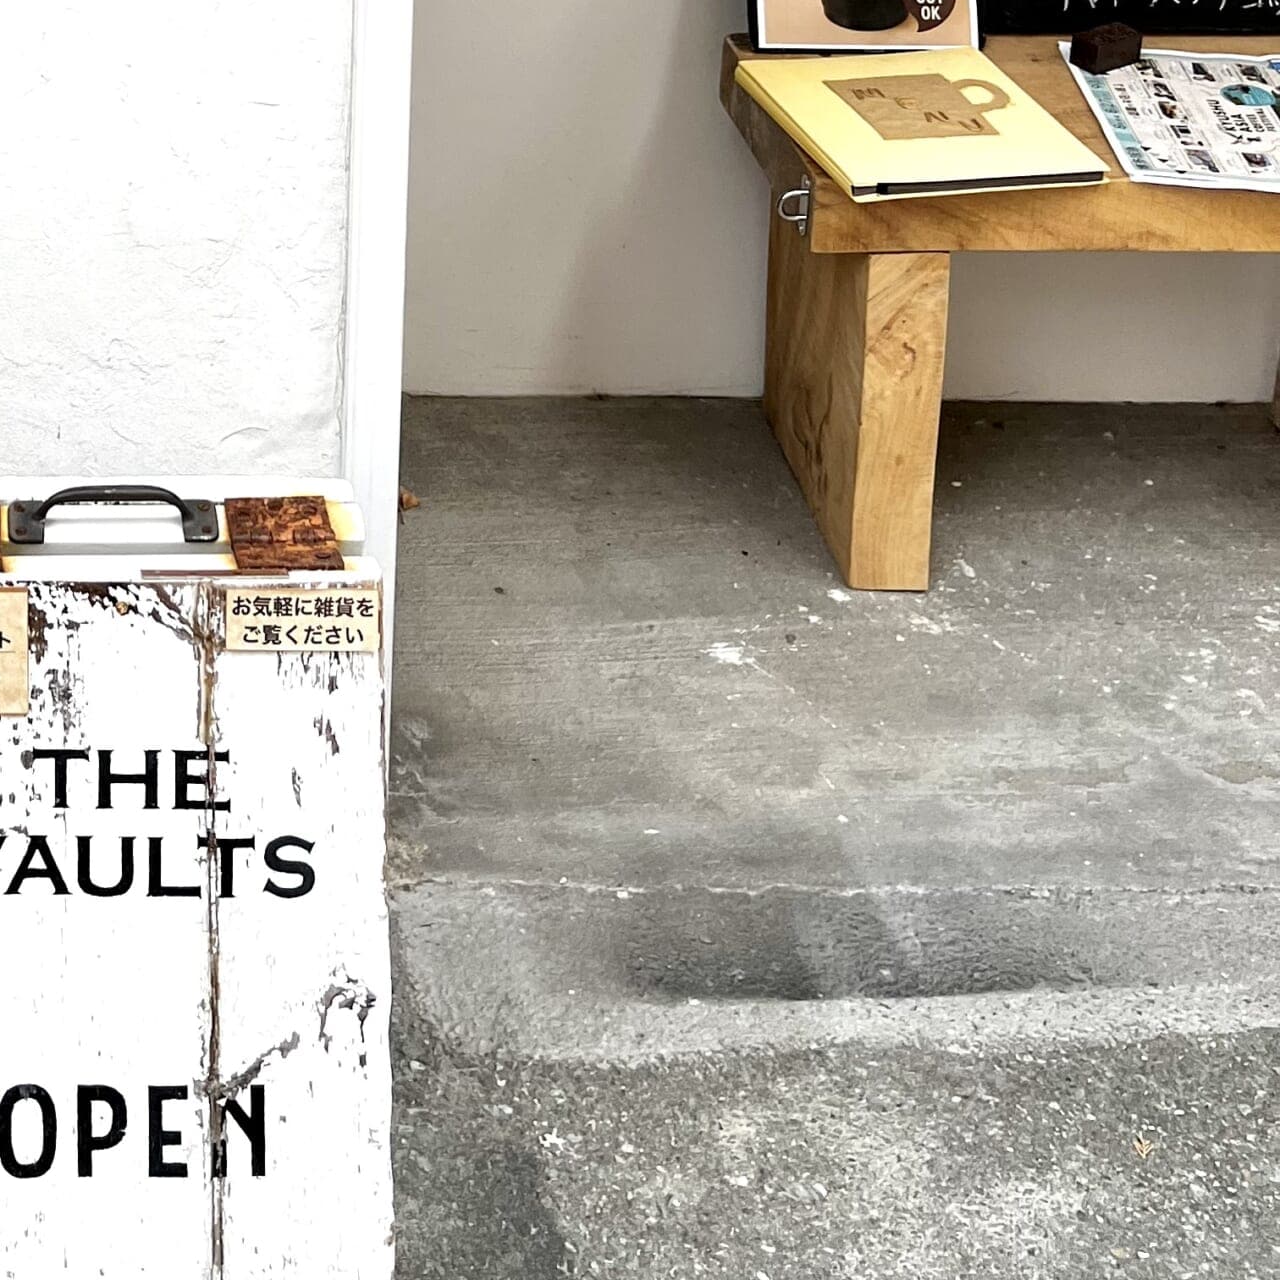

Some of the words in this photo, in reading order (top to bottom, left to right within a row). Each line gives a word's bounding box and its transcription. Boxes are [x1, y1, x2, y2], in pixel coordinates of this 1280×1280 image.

[920, 6, 941, 20] OK
[231, 595, 374, 619] お気軽に雑貨を
[242, 624, 365, 646] ご覧ください
[33, 747, 231, 811] THE
